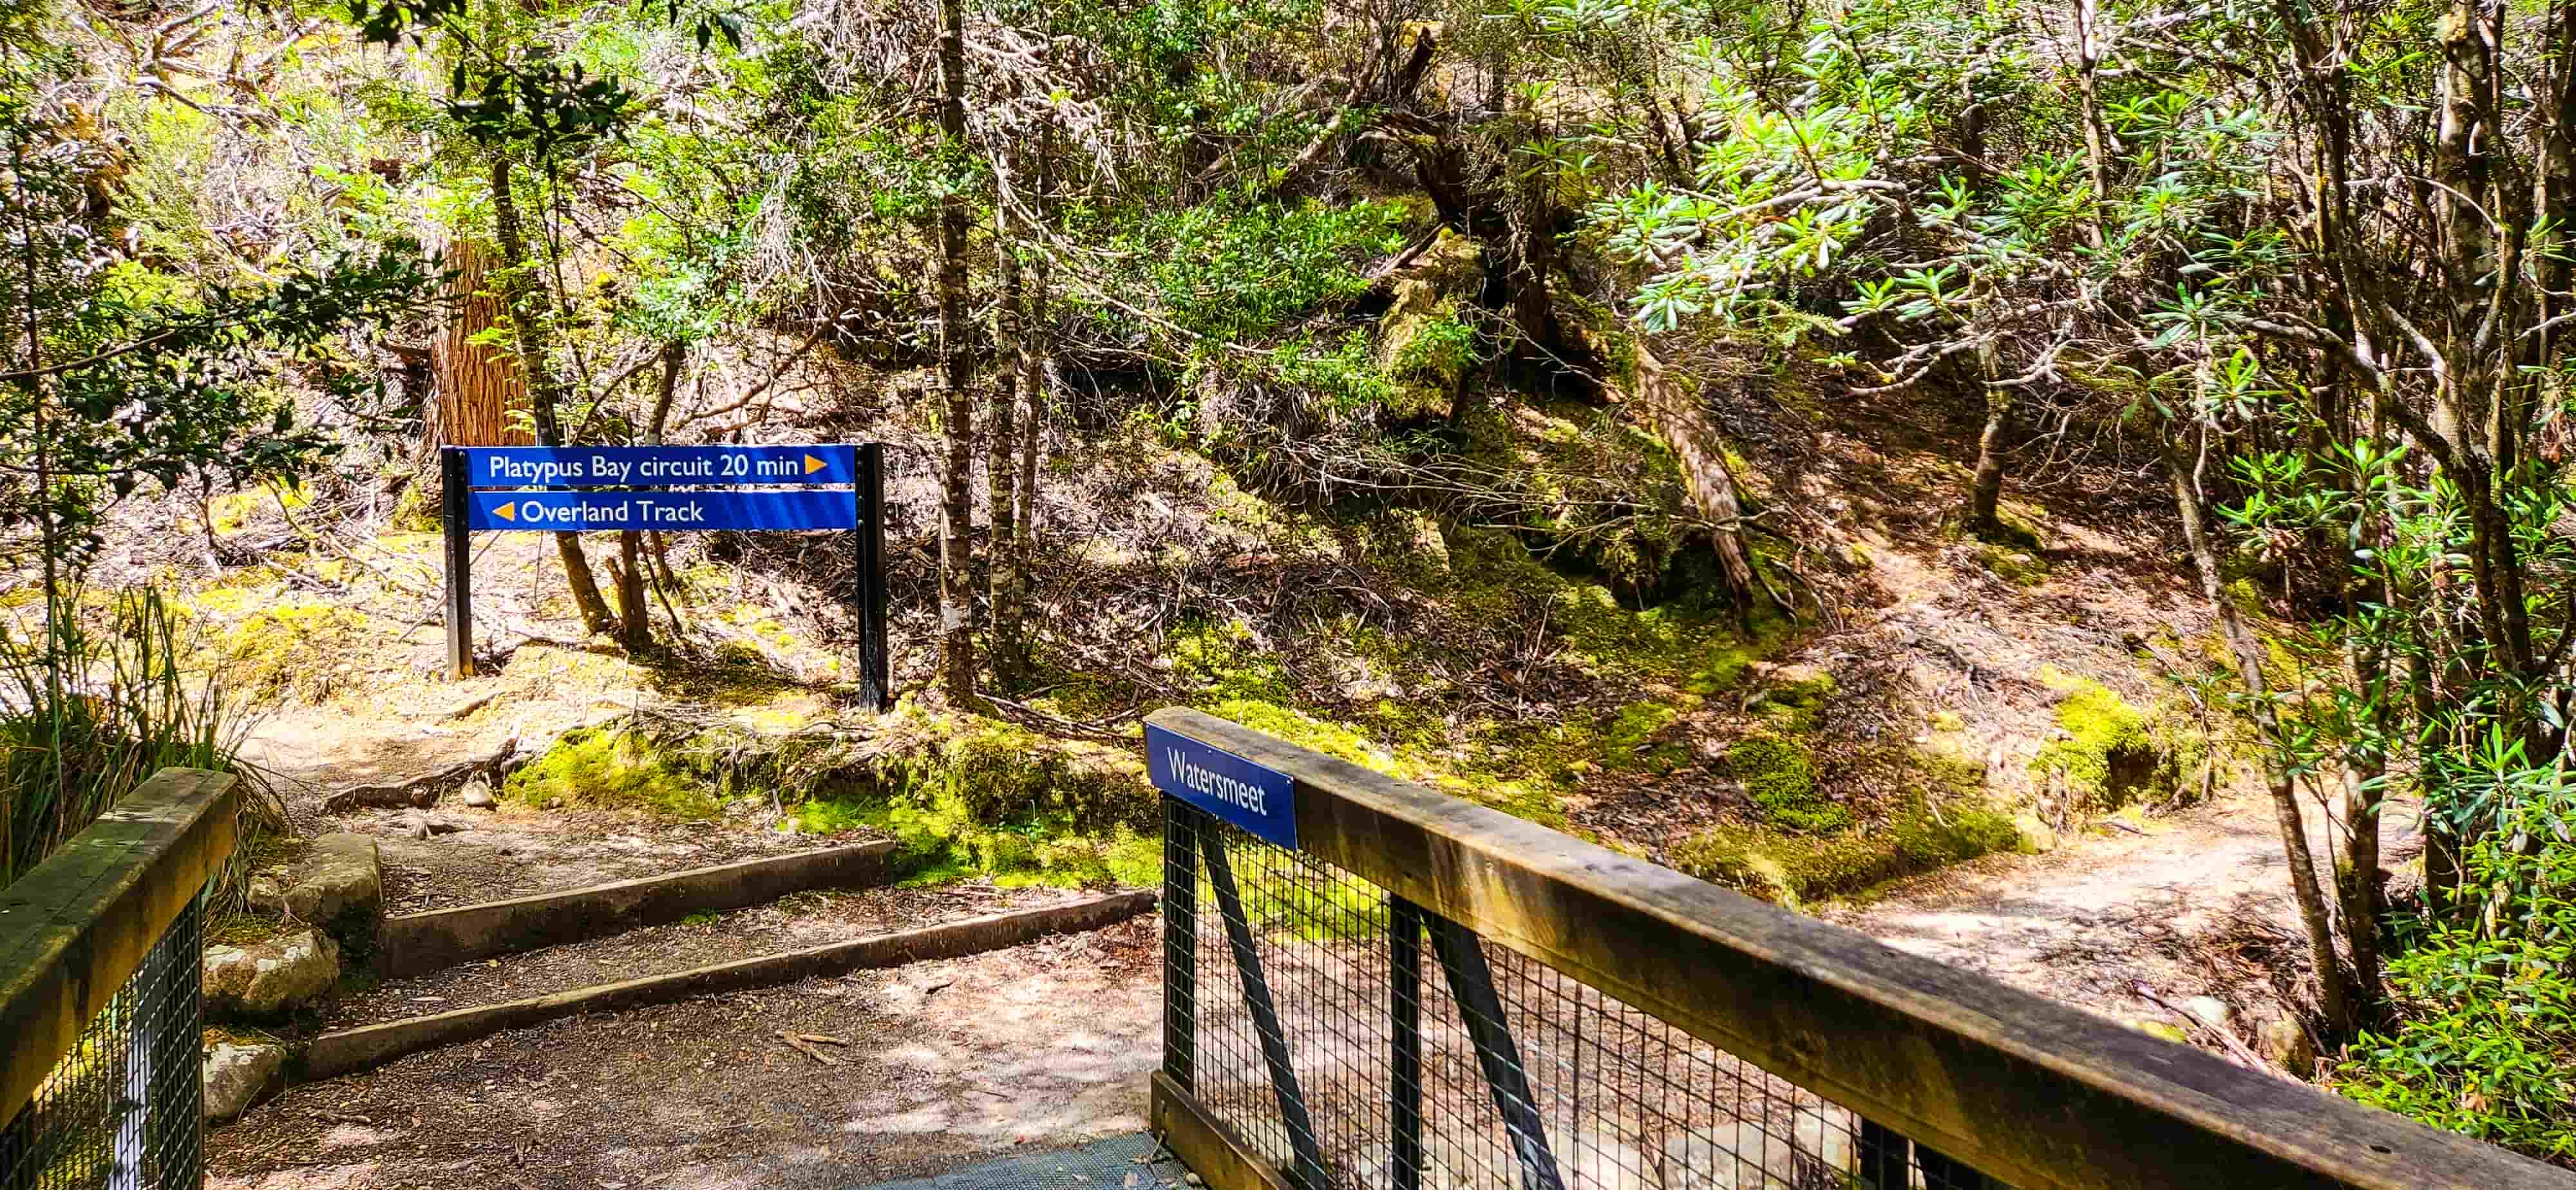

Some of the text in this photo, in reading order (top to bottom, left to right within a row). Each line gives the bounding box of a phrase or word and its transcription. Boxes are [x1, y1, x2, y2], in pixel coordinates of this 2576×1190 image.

[490, 454, 798, 484] Platypus Bay circuit 20 min
[522, 500, 704, 522] Overland Track
[1166, 746, 1267, 816] Watersmeet
